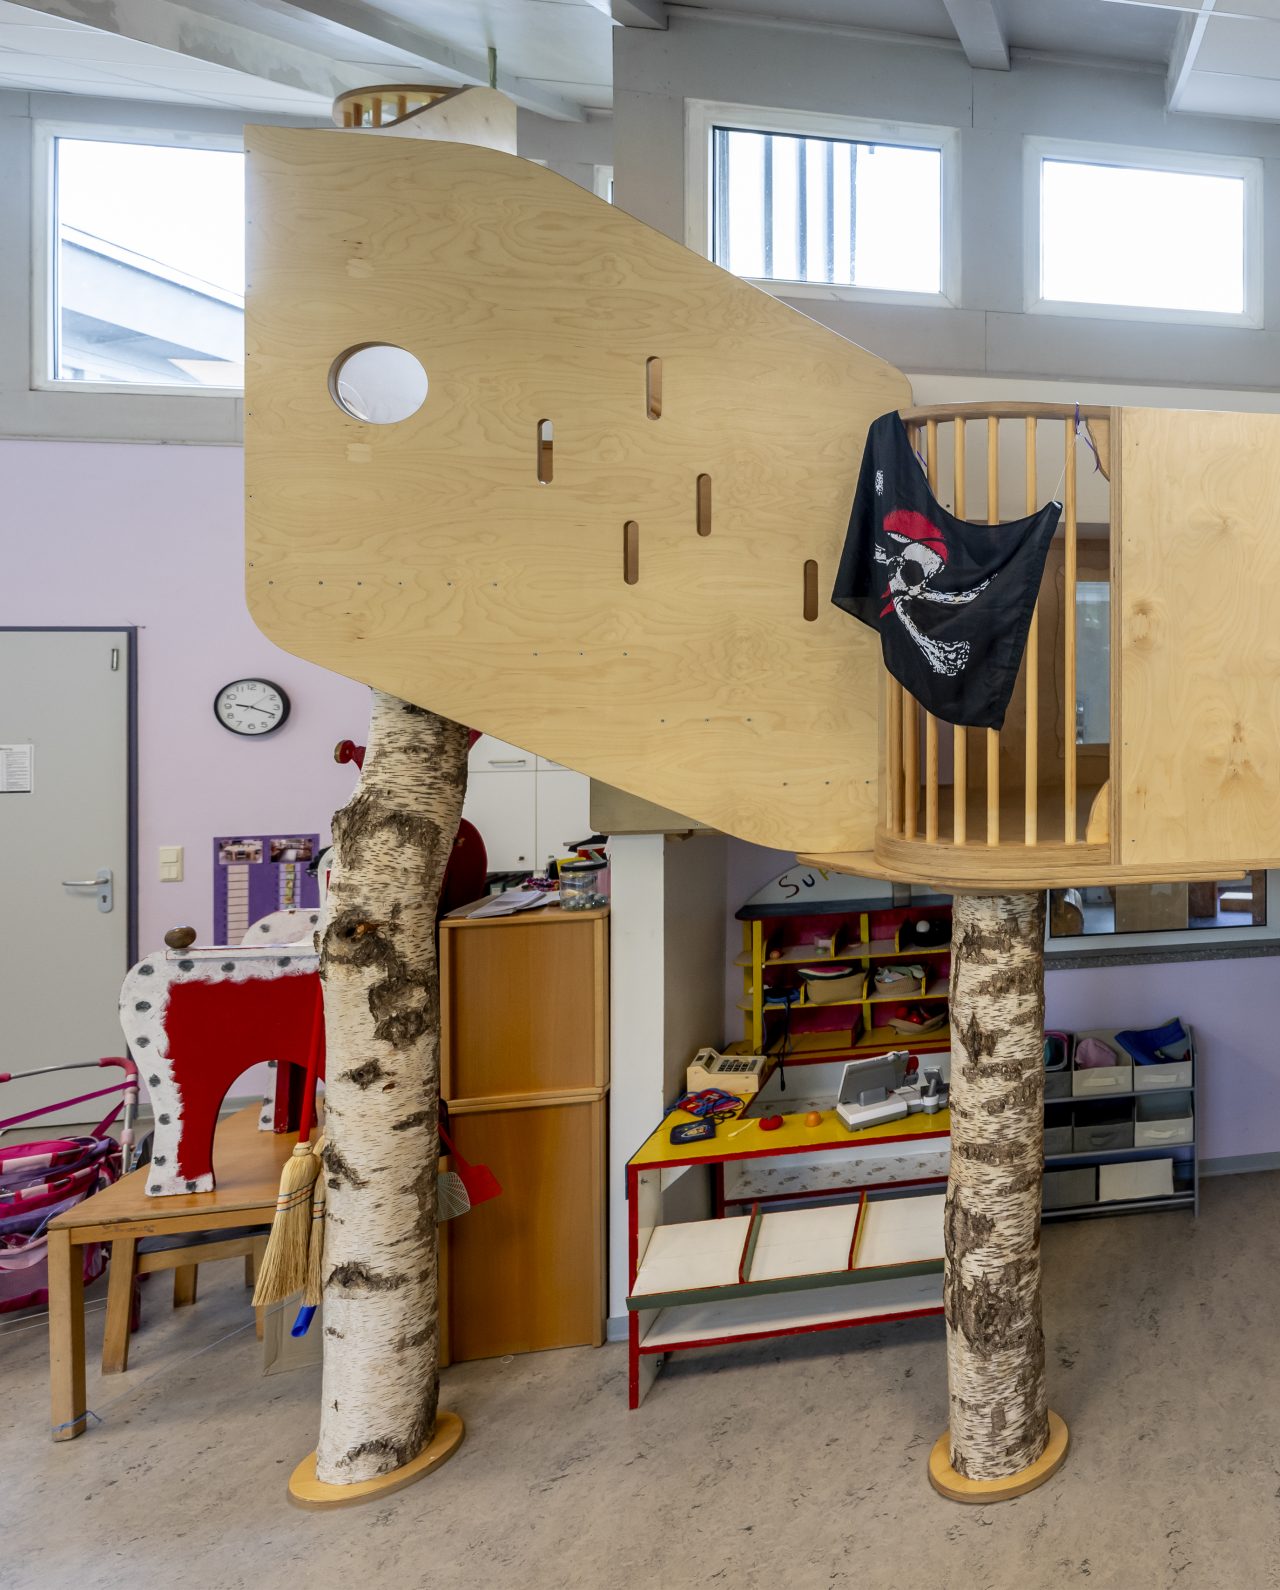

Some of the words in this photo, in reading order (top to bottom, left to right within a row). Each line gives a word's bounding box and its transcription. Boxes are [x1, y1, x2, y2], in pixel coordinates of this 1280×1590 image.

[246, 683, 257, 691] 12
[227, 712, 235, 720] 8
[235, 720, 243, 728] 7
[261, 721, 268, 729] 5
